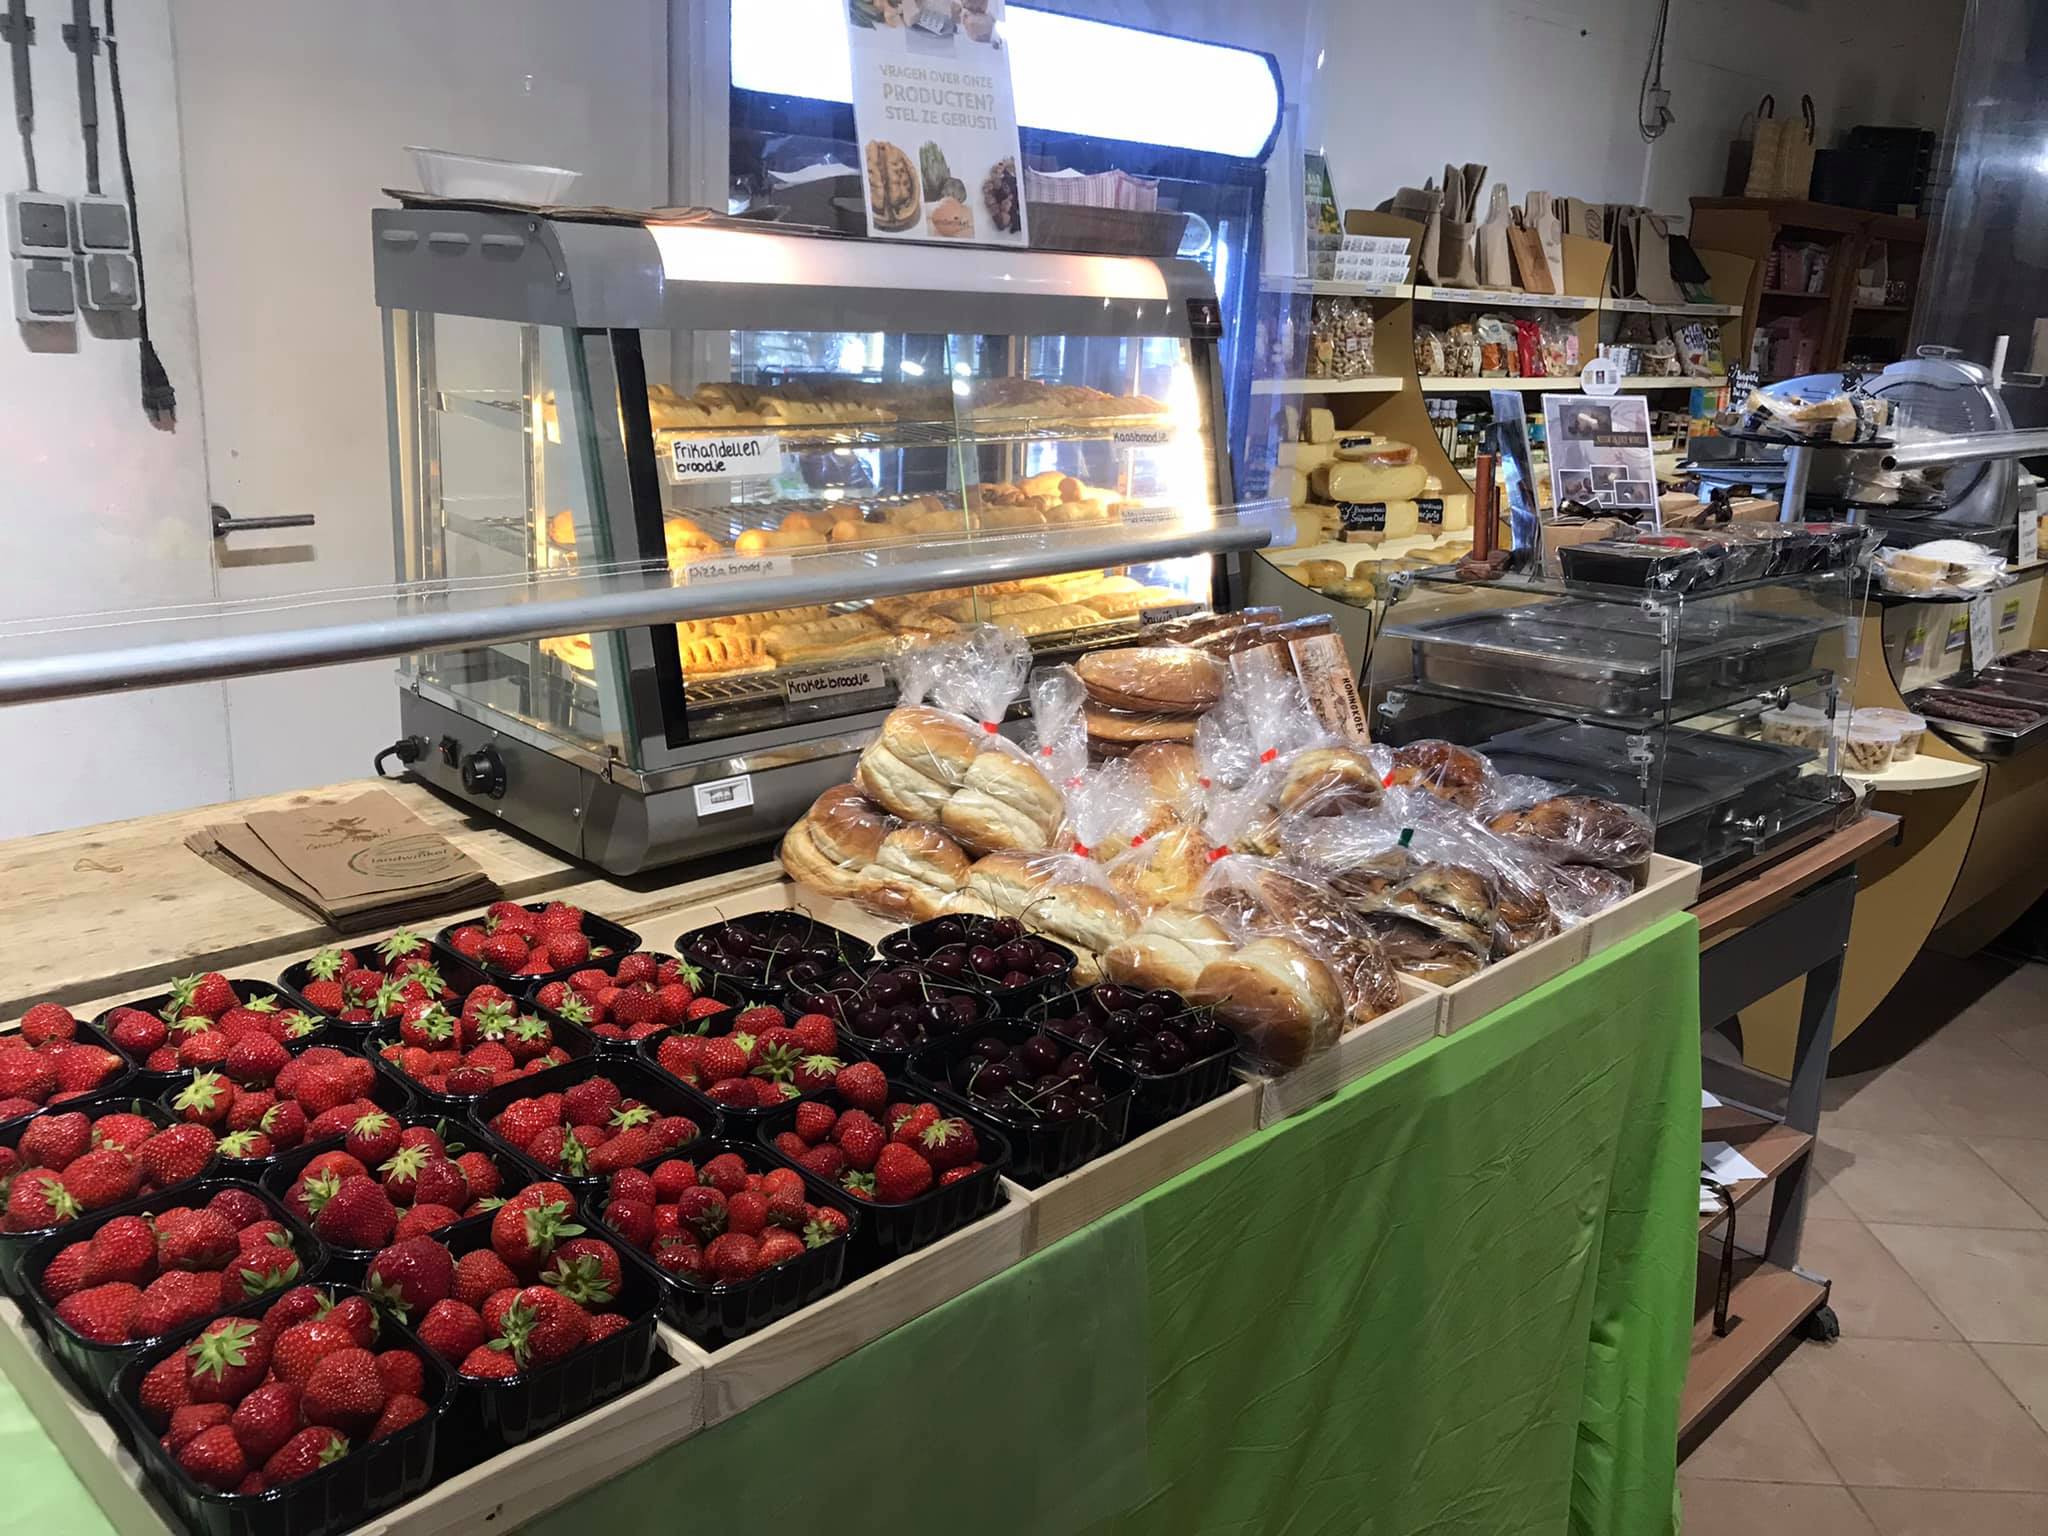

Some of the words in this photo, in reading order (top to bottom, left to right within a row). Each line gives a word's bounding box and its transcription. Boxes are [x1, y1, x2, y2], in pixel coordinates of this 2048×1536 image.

[880, 65, 927, 80] VRAGEN
[930, 71, 960, 84] OVER
[963, 75, 993, 88] ONZE
[883, 83, 994, 112] PRODUCTEN?
[885, 106, 918, 122] STEL
[921, 110, 939, 124] ZE
[673, 440, 761, 460] Frikandellen
[676, 460, 727, 474] broodje
[1342, 678, 1365, 735] HONINGKOEK
